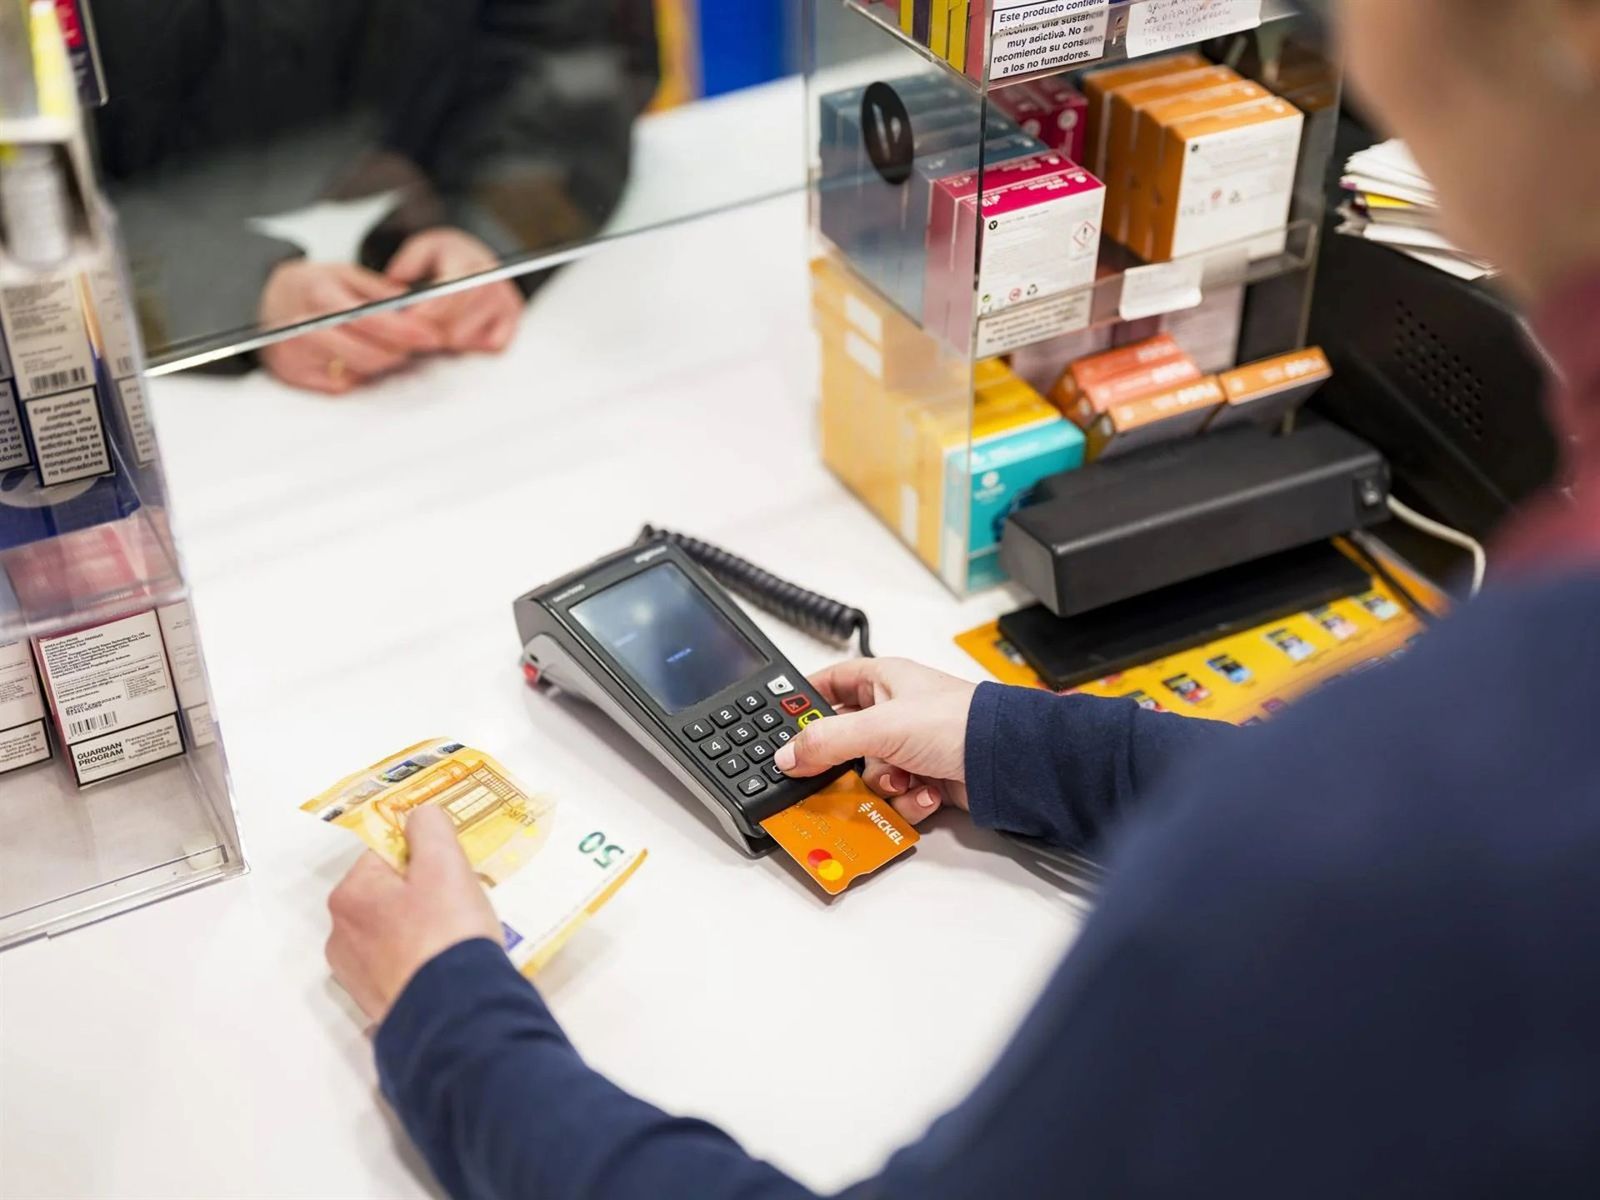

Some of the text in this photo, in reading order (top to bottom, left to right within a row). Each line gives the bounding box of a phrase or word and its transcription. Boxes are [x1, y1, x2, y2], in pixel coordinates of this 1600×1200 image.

[1000, 13, 1020, 22] Este
[1022, 4, 1064, 22] producto
[1042, 20, 1059, 28] una
[1061, 10, 1104, 25] sustancia
[1007, 25, 1094, 48] muy adictiva. No se
[994, 34, 1103, 64] recomienda su consumo
[1002, 50, 1090, 74] a los no fumadores.
[693, 696, 758, 733] 1 2 3
[711, 714, 774, 750] 4 5 6
[77, 742, 122, 760] GUARDIAN
[79, 748, 124, 766] PROGRAM
[728, 731, 790, 768] 7 8 9
[578, 831, 624, 868] 50
